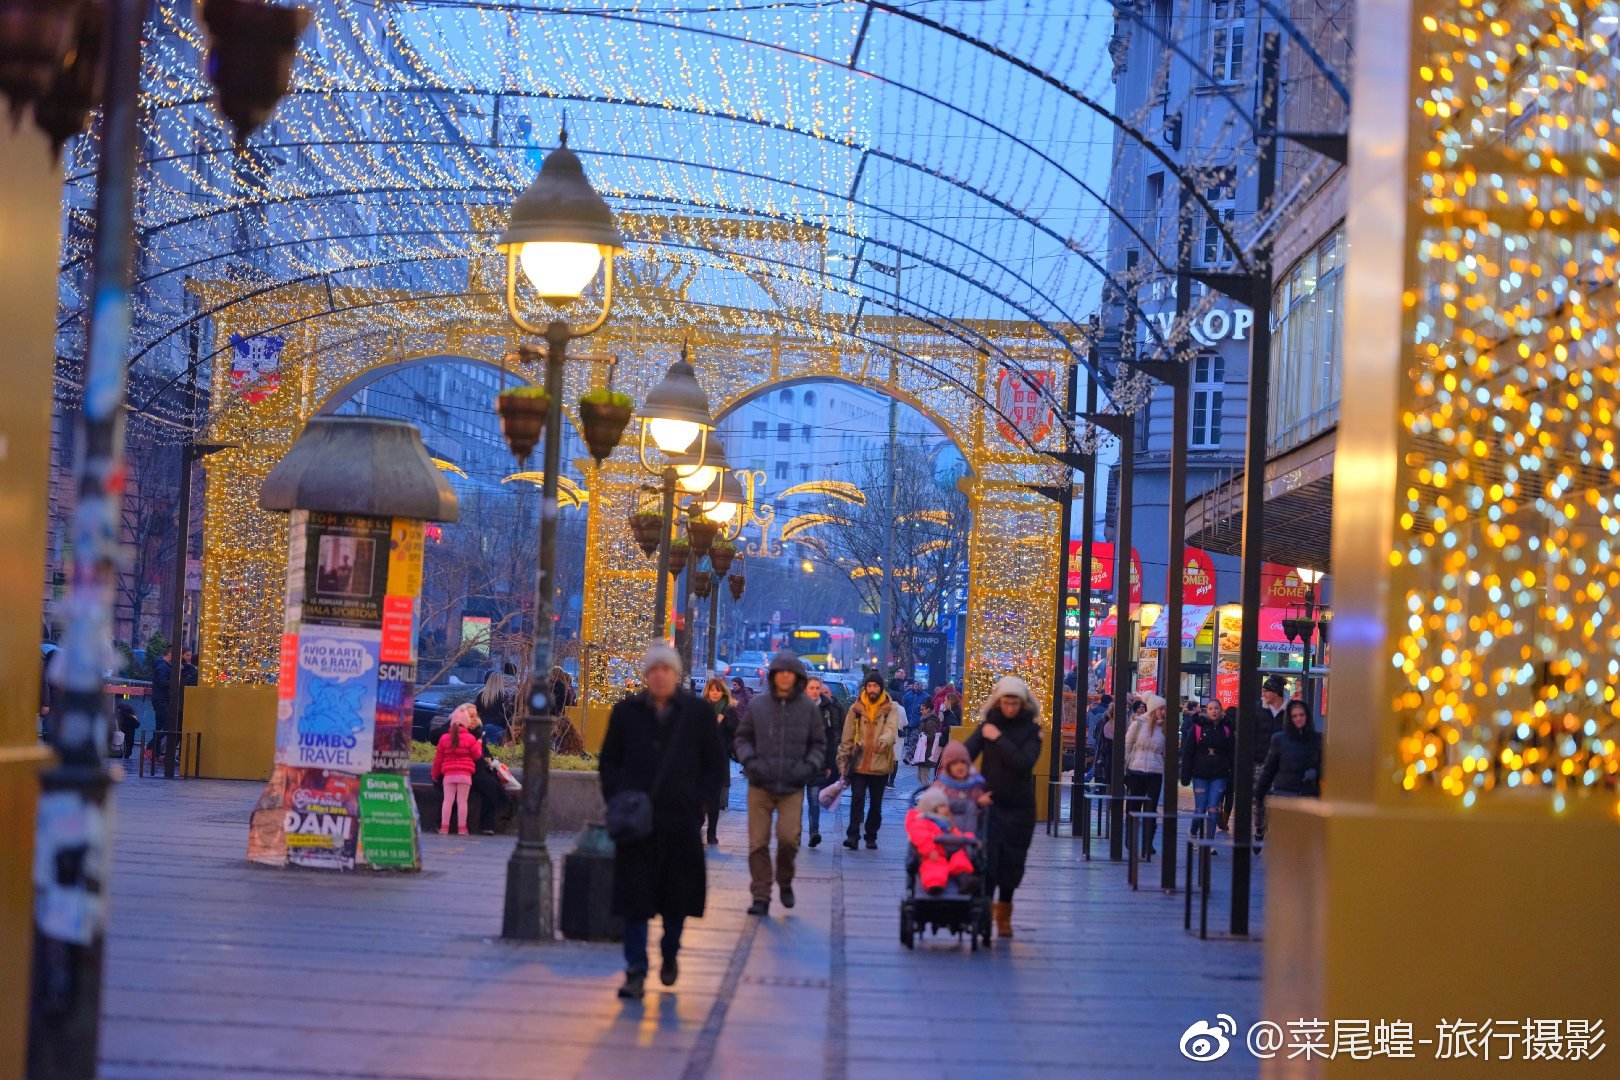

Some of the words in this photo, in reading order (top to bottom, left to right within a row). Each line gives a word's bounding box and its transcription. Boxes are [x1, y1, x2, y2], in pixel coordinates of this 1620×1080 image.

[1183, 575, 1209, 585] OMER
[912, 636, 940, 645] ITYINFO
[303, 645, 327, 656] AVIO
[329, 647, 363, 658] KARTE
[304, 656, 319, 666] NA
[321, 657, 327, 666] 6
[330, 658, 362, 668] RATA!
[298, 733, 357, 749] JUMBO
[299, 747, 353, 765] TRAVEL
